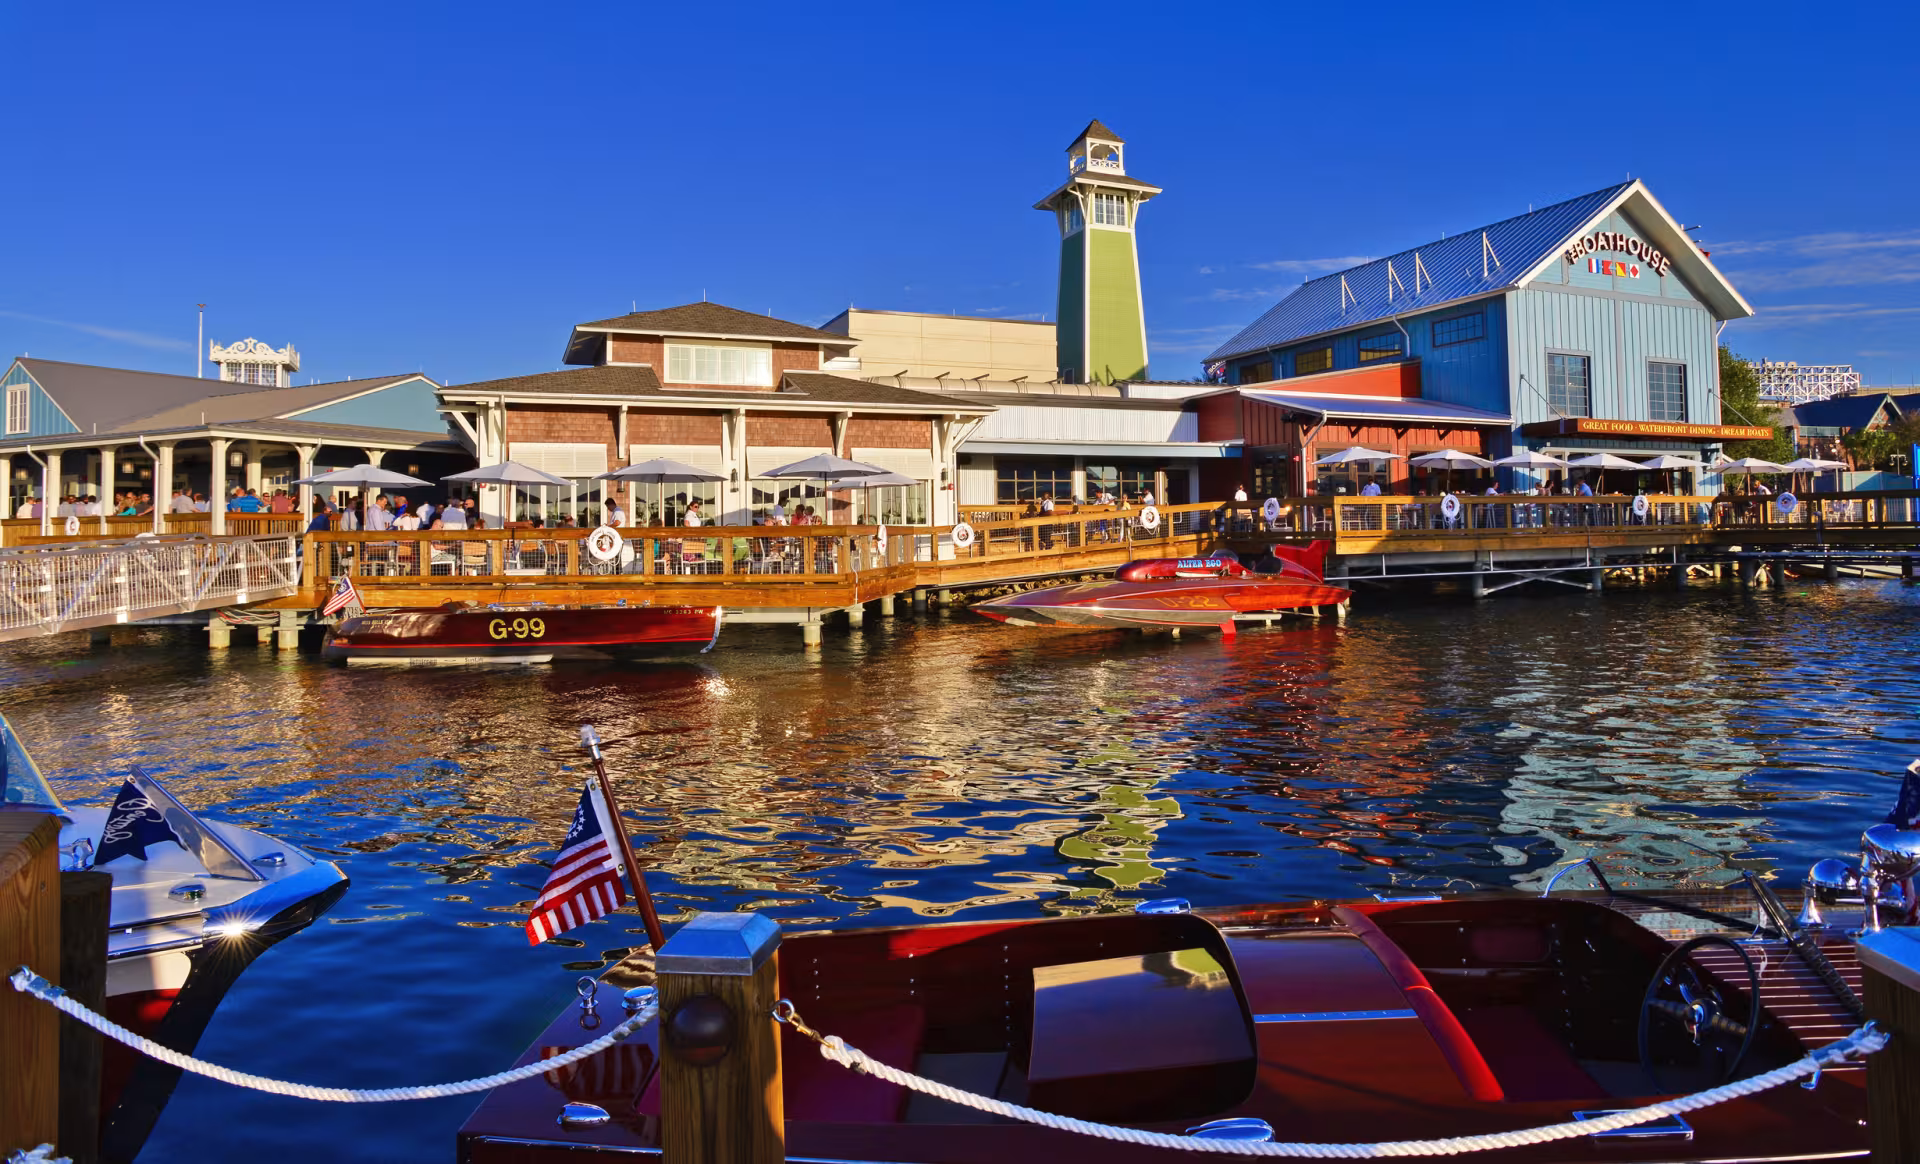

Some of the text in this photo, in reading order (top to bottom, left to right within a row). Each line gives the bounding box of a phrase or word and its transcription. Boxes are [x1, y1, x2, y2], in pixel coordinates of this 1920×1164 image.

[1574, 231, 1671, 277] BOATHOUSE
[1583, 421, 1769, 437] GREAT FOOD WATERFRONT DINING DREAM BOATS
[1177, 560, 1221, 568] ALTER EGO
[1155, 596, 1218, 607] U-22
[489, 618, 545, 640] G-99
